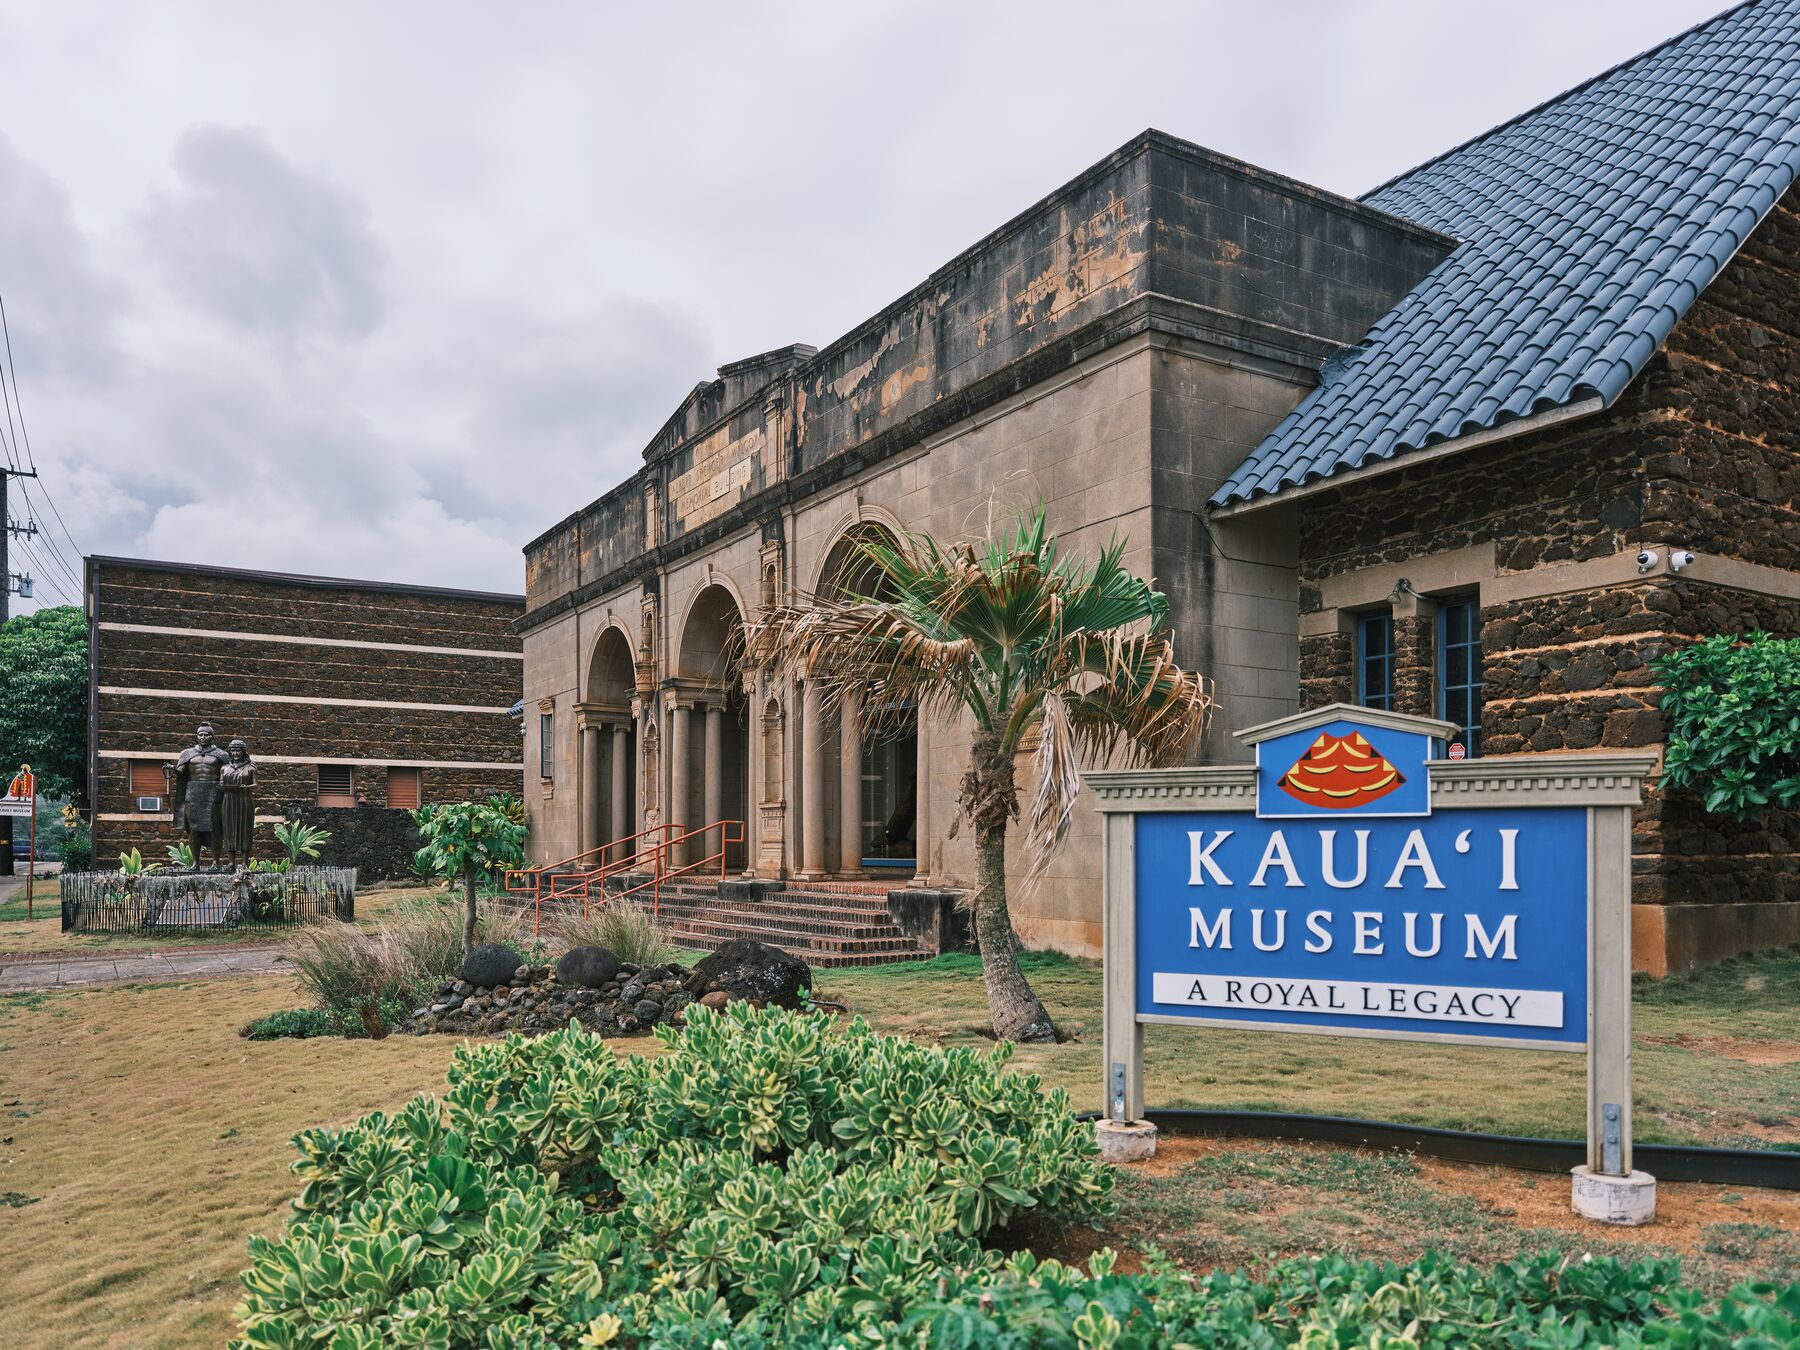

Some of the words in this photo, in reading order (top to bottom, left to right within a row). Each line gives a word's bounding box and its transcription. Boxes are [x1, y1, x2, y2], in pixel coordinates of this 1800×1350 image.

[672, 474, 691, 495] ALBERT
[696, 453, 723, 482] SPENCER
[681, 484, 710, 512] MEMORIAL
[714, 465, 746, 493] BUILDING
[1188, 907, 1518, 960] MUSEUM
[1187, 979, 1208, 1001] A
[1225, 980, 1345, 1009] ROYAL
[1361, 987, 1521, 1019] LEGACY
